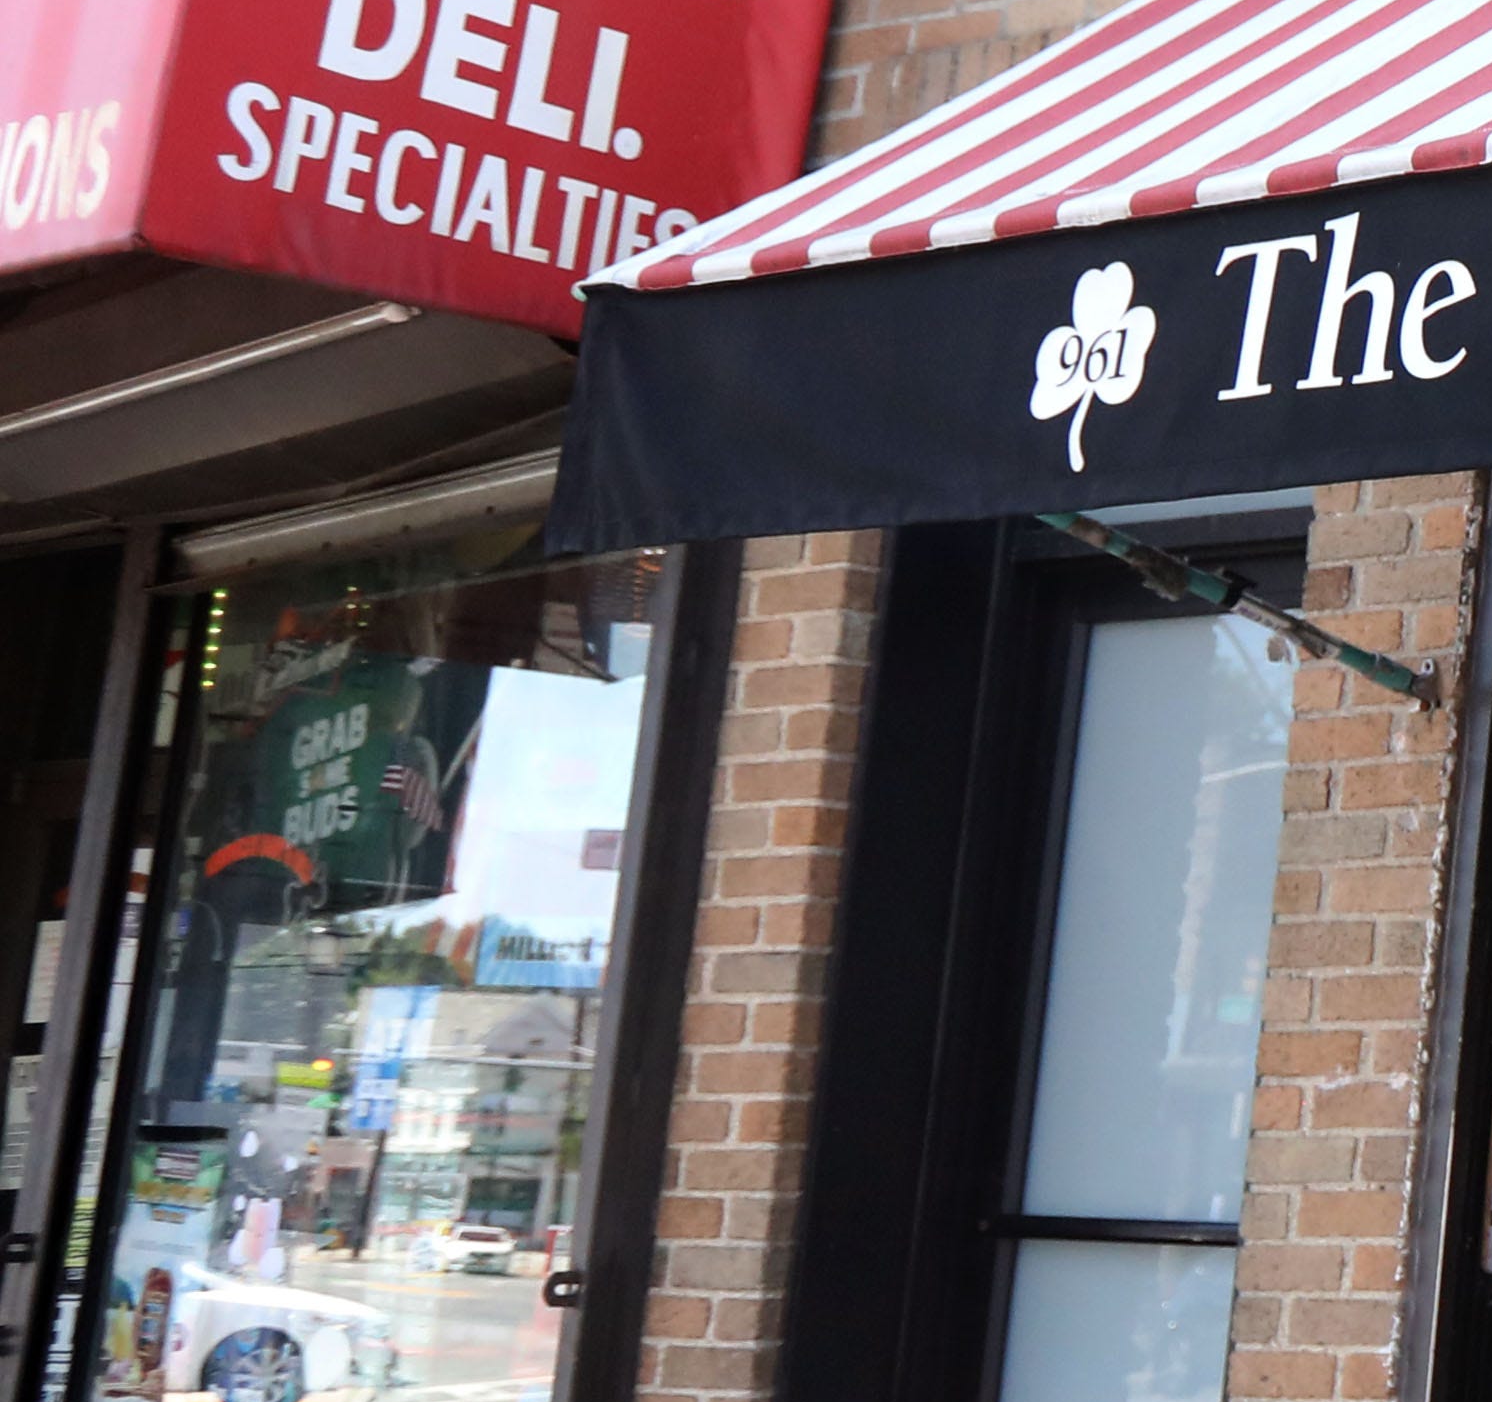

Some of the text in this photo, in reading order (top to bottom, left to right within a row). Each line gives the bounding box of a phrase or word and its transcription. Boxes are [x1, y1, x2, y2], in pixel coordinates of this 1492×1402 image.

[1058, 324, 1132, 392] 961
[1214, 215, 1475, 400] The
[292, 703, 369, 769] GRAB
[284, 785, 359, 846] BUDS
